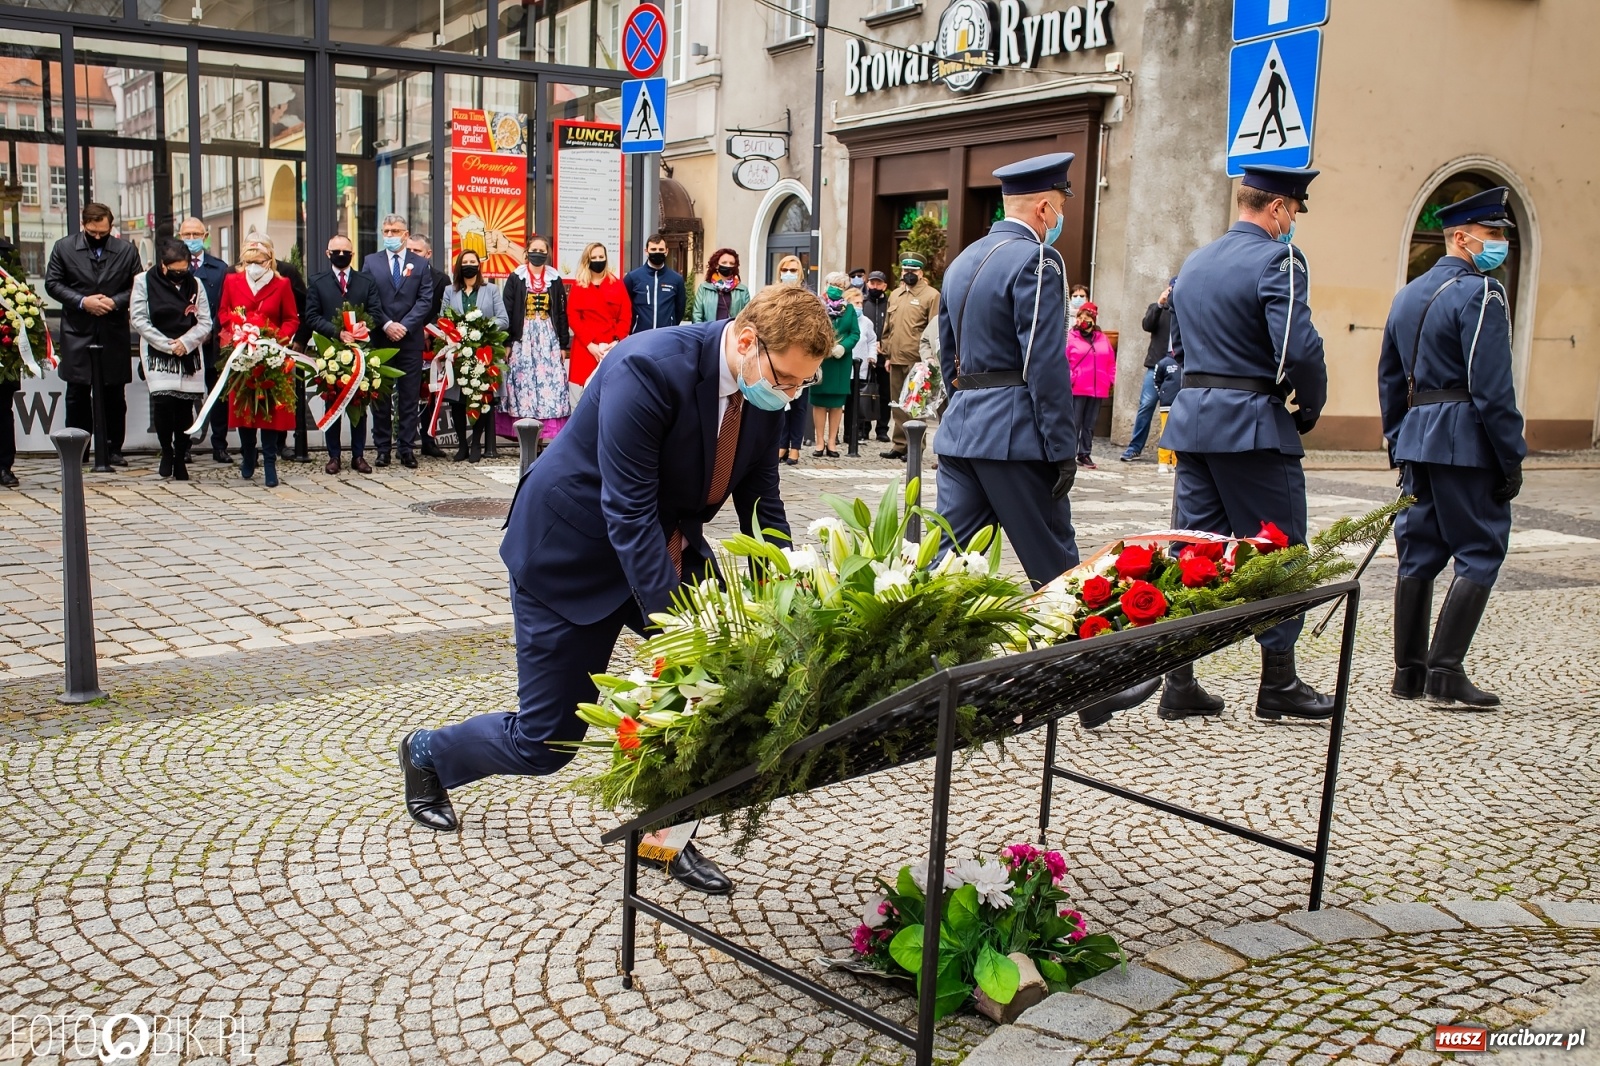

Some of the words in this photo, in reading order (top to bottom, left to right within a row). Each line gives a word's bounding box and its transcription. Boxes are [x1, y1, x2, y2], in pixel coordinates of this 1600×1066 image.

[845, 38, 937, 96] Browar
[998, 0, 1109, 69] Rynek
[938, 60, 963, 78] Browar
[964, 51, 987, 71] Rynek
[453, 111, 468, 120] Pizza
[469, 112, 485, 121] Time
[453, 122, 472, 134] Druga
[473, 124, 487, 134] pizza
[568, 127, 614, 142] LUNCH
[461, 133, 483, 146] gratis!
[743, 139, 775, 153] BUTIK
[462, 155, 518, 176] Promocja
[470, 176, 488, 185] DWA
[490, 177, 509, 186] PIWA
[457, 184, 465, 192] W
[466, 185, 487, 193] CENIE
[488, 186, 522, 196] JEDNEGO
